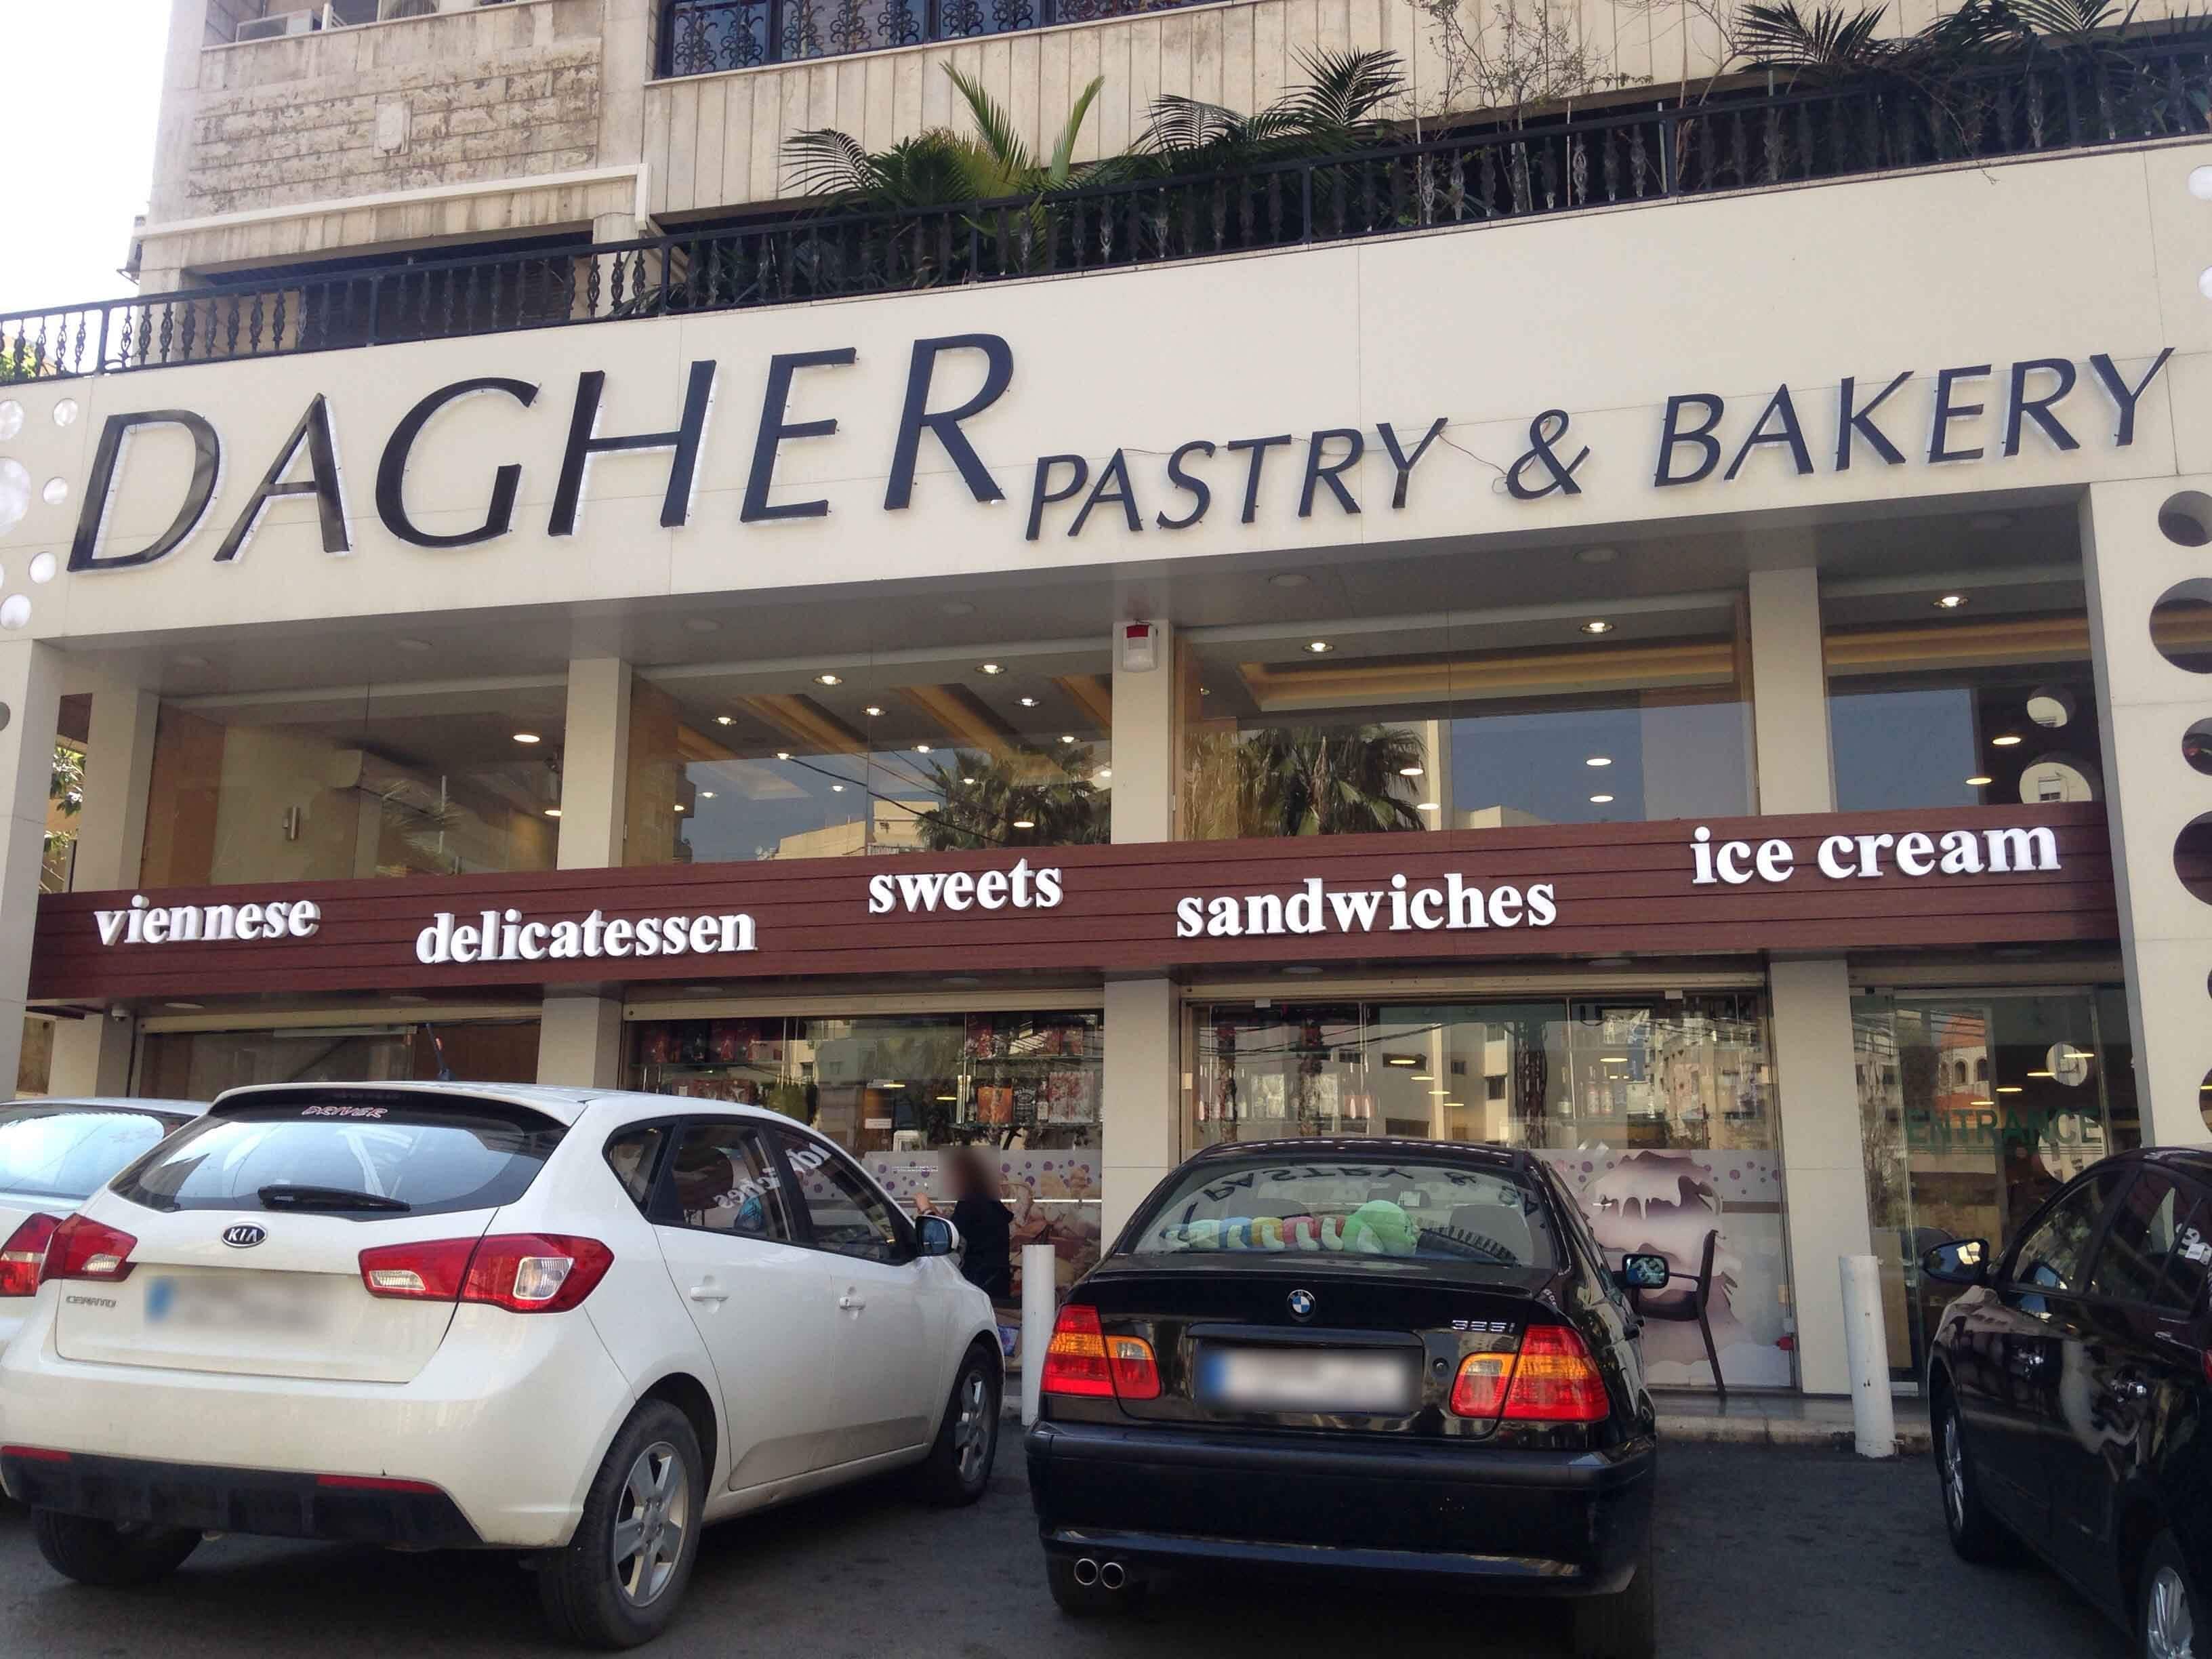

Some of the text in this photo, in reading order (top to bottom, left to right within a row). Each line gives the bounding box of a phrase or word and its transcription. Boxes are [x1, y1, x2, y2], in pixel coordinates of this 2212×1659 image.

[66, 333, 2175, 573] DAGHER PASTRY & BAKERY
[1689, 826, 2062, 884] ice cream
[869, 858, 1063, 914] sweets
[1176, 872, 1557, 937] sandwiches
[94, 895, 321, 945] viennese
[415, 909, 758, 964] delicatessen
[1905, 1106, 2102, 1145] ENTRANCE
[228, 1227, 258, 1242] KIA
